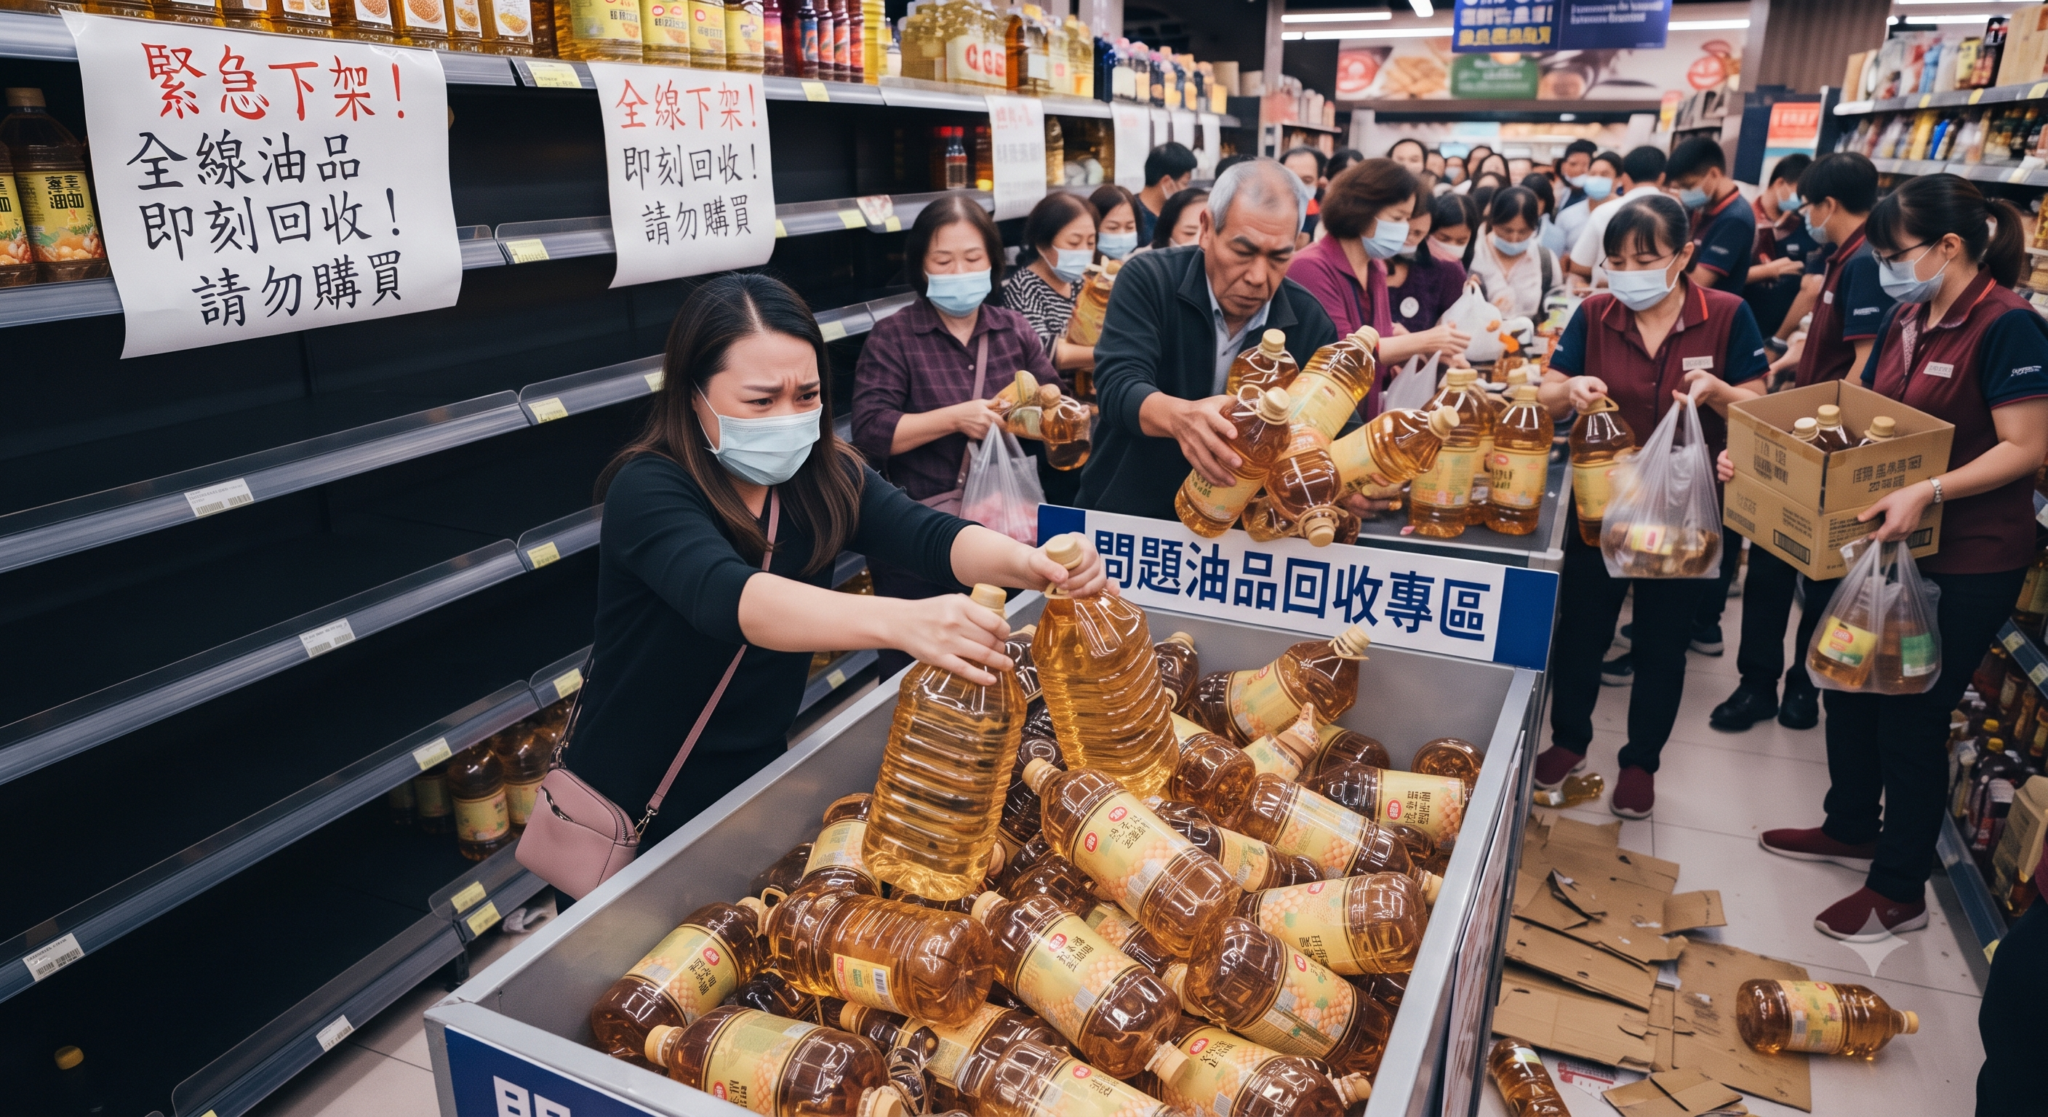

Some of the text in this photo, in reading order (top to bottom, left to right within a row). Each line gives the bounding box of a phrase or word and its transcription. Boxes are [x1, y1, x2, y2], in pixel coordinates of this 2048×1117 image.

[140, 41, 405, 122] 緊急下架！
[615, 79, 758, 131] 全線下架！
[127, 129, 361, 191] 全線油品
[623, 143, 758, 190] 即刻回收！
[138, 188, 401, 261] 即刻回收！
[641, 194, 752, 246] 請勿購買
[192, 250, 402, 327] 請勿購買
[1094, 529, 1492, 642] 問題油品回收專區
